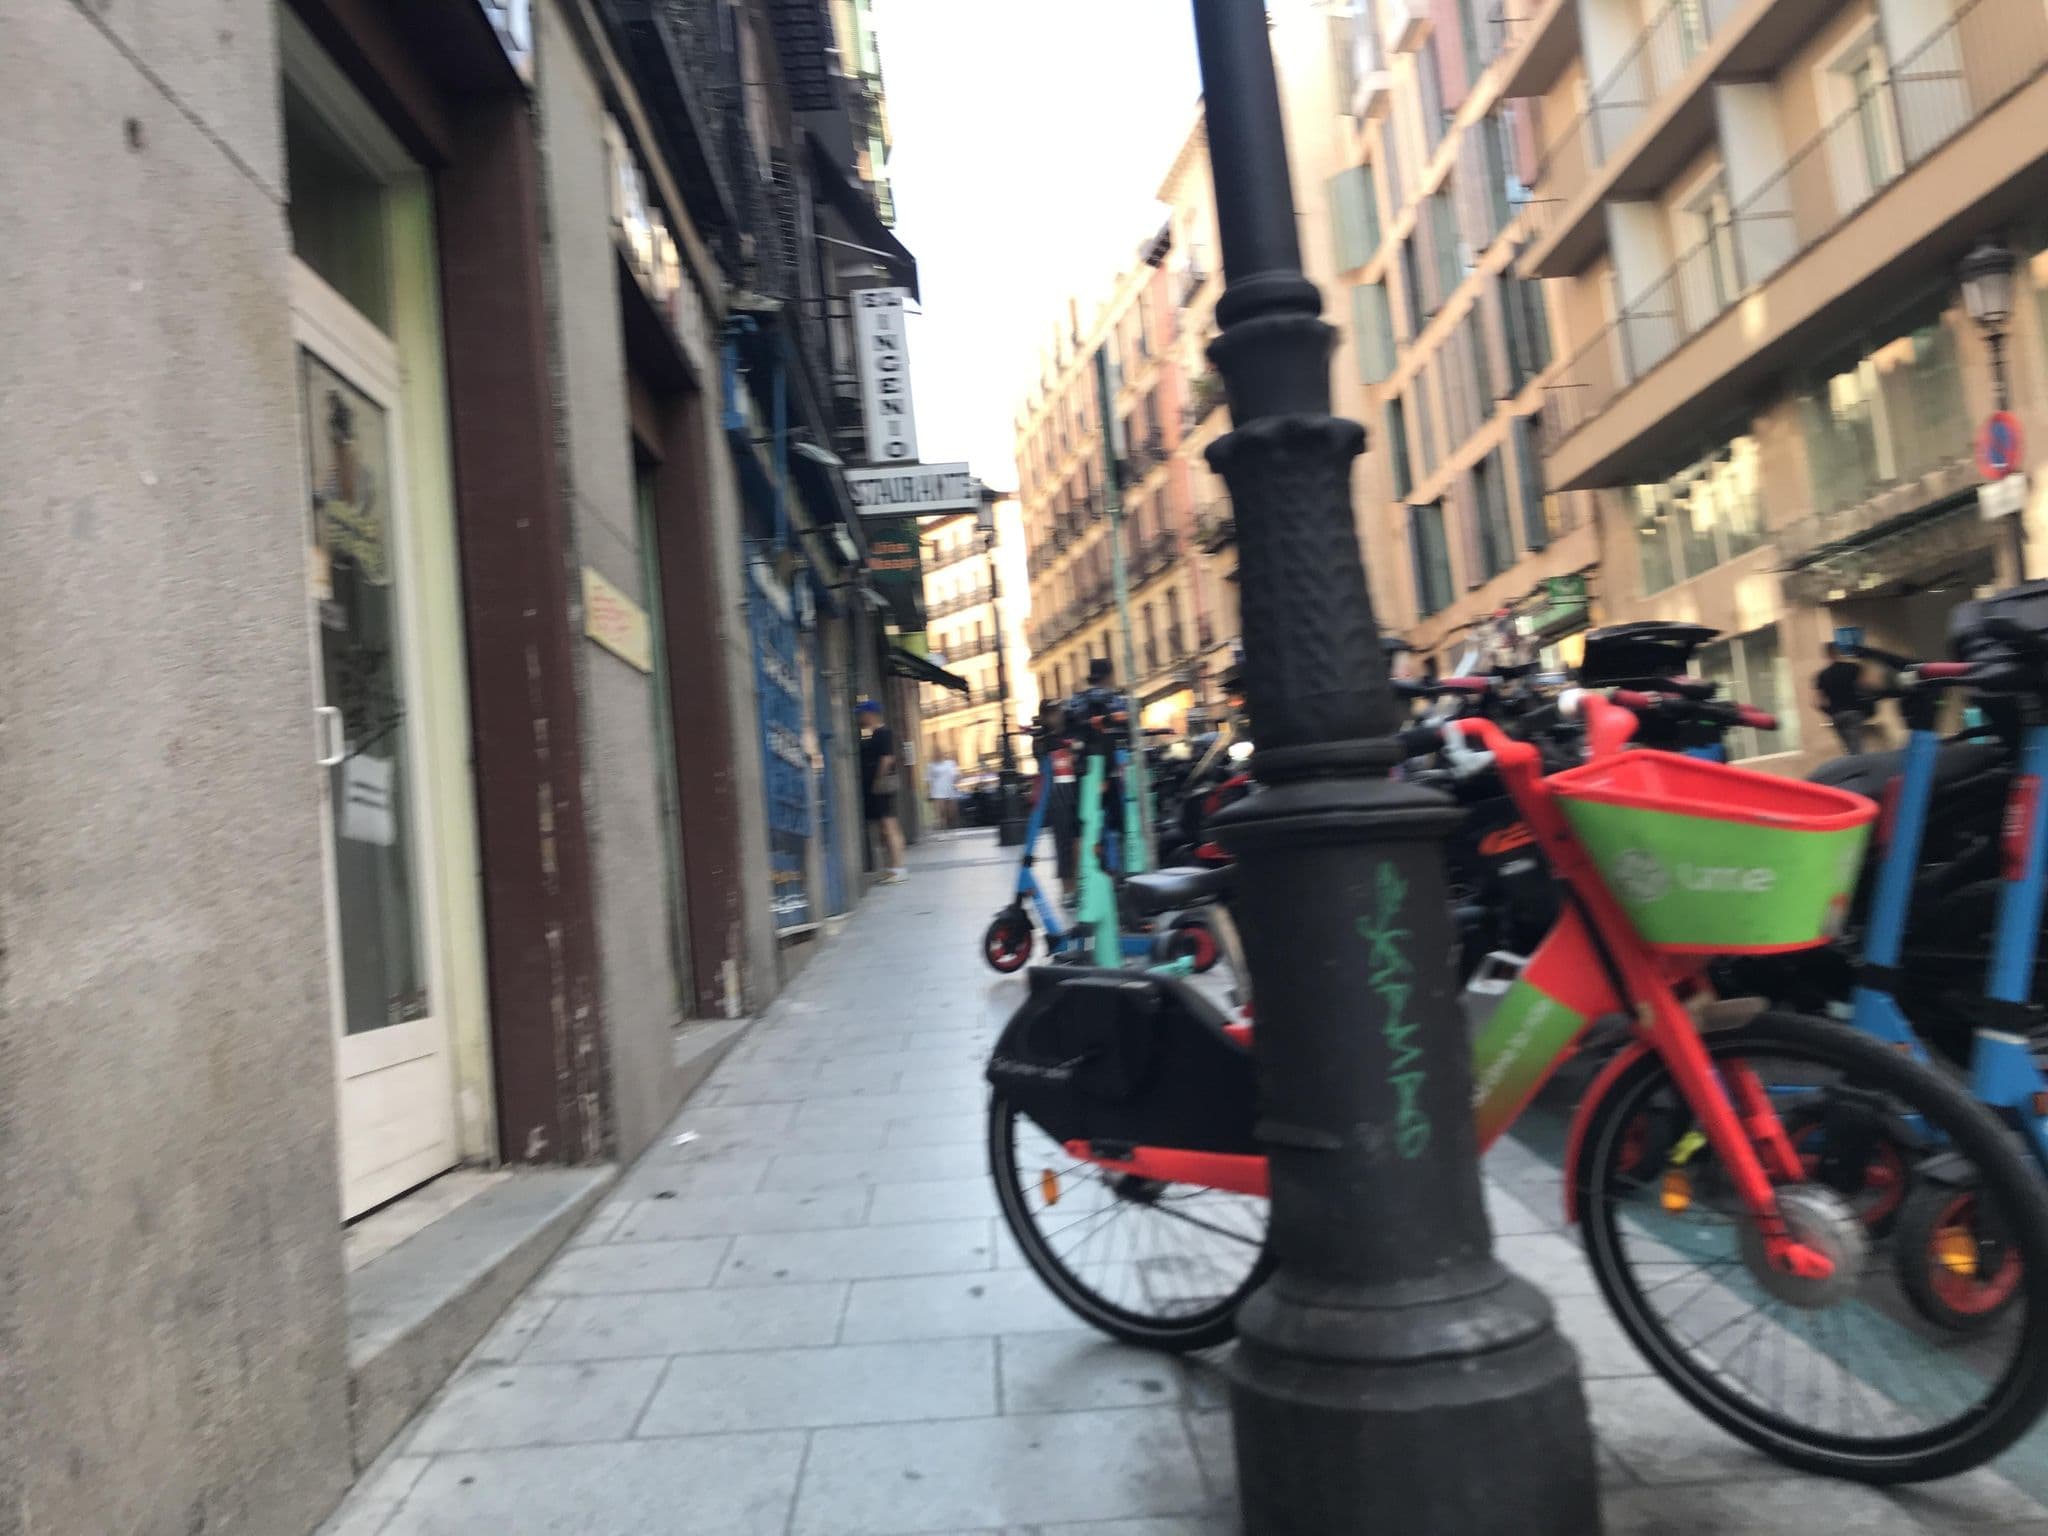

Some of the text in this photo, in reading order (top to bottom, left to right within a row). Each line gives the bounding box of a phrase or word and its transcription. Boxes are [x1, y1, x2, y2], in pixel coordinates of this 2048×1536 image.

[862, 292, 903, 308] EL
[873, 313, 909, 458] INGENIO
[849, 473, 976, 506] STAURANTE
